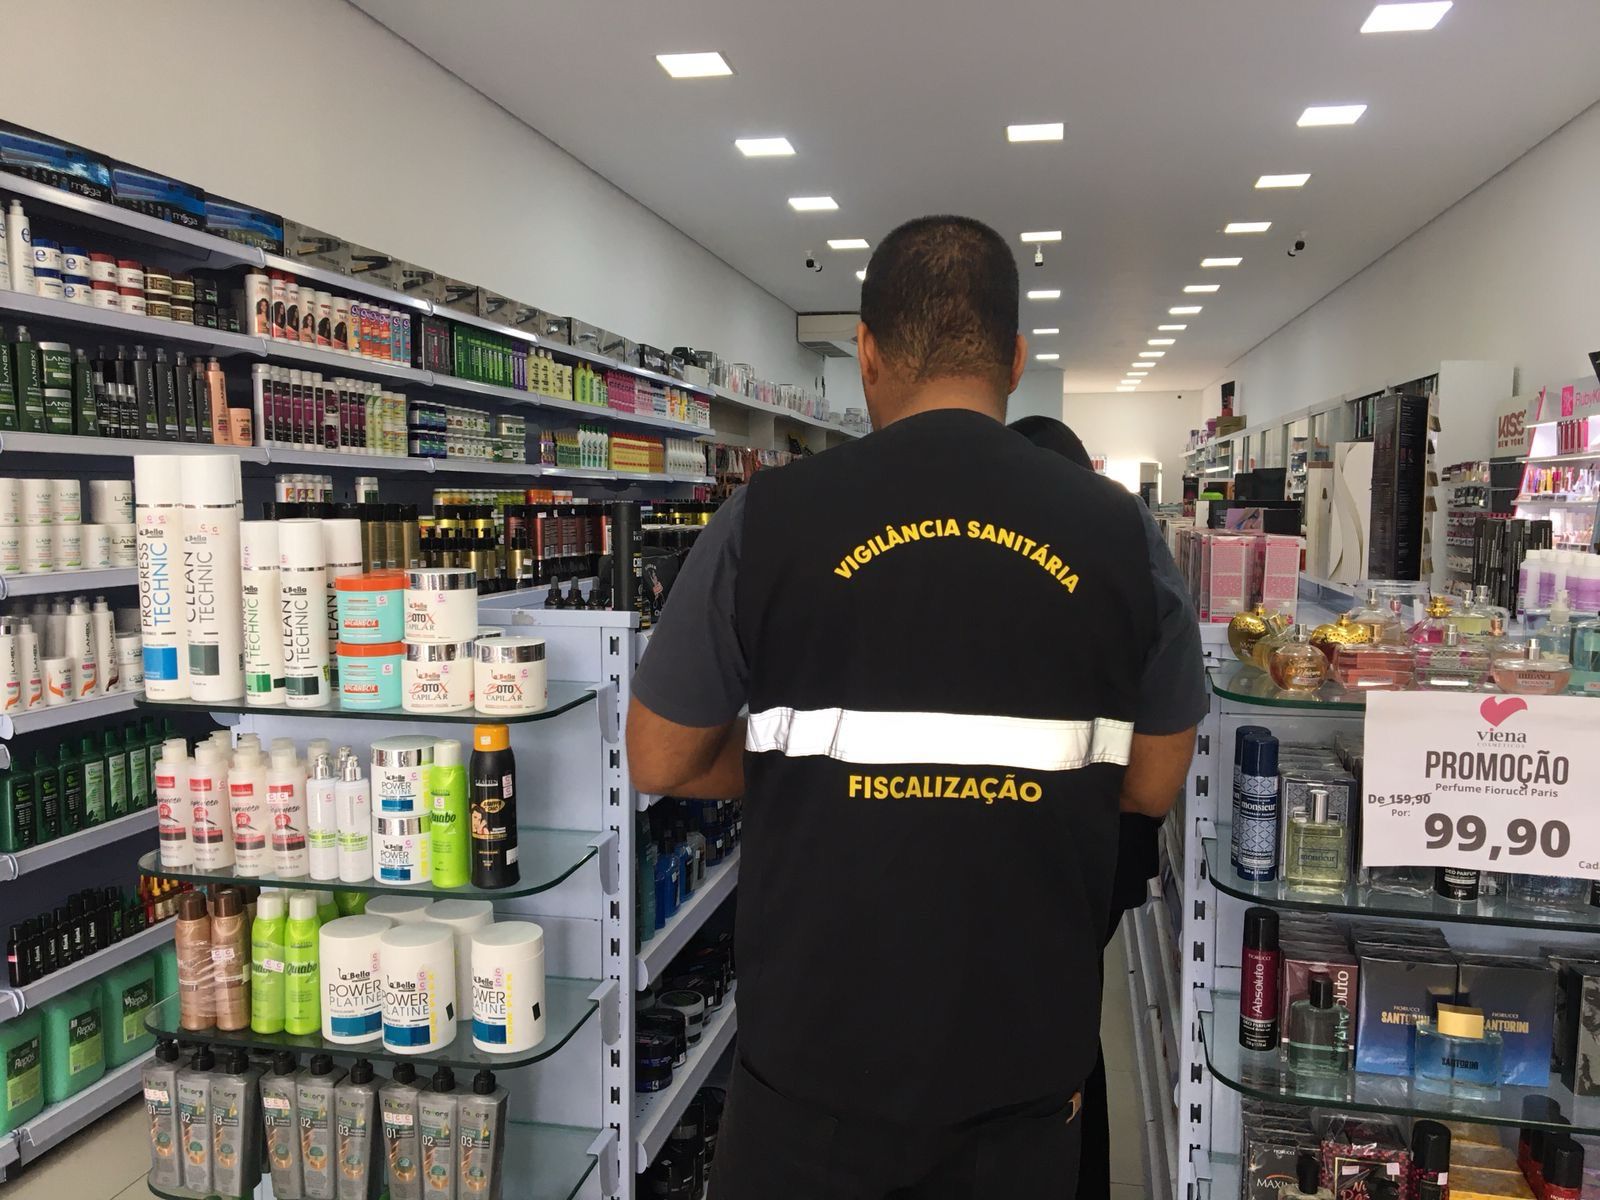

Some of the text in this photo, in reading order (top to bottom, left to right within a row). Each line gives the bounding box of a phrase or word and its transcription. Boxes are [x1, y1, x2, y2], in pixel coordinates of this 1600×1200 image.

[1498, 411, 1526, 439] KISS
[834, 518, 1080, 594] VIGILÂNCIA SANITÁRIA
[138, 543, 152, 627] PROGRESS
[150, 543, 171, 627] TECHNIC
[183, 552, 196, 622] CLEAN
[196, 551, 215, 624] TECHNIC
[247, 598, 261, 657] TECHNIC
[282, 600, 294, 662] CLEAN
[294, 599, 310, 662] TECHNIC
[409, 682, 448, 694] BOTOX
[483, 683, 523, 694] BOTOX
[1477, 728, 1527, 743] viena
[1425, 750, 1569, 790] PROMOÇÃO
[382, 782, 412, 790] POWER
[849, 774, 1042, 804] FISCALIZAÇÃO
[1368, 793, 1431, 806] De 159,90
[1435, 783, 1558, 798] Perfume Fiorucci Paris
[1391, 808, 1411, 817] Por:
[1425, 813, 1571, 861] 99,90
[380, 850, 409, 859] POWER
[328, 979, 381, 998] POWER
[381, 989, 429, 1007] POWER
[1252, 964, 1264, 1014] Absoluto
[1484, 1018, 1529, 1034] ANTORINI
